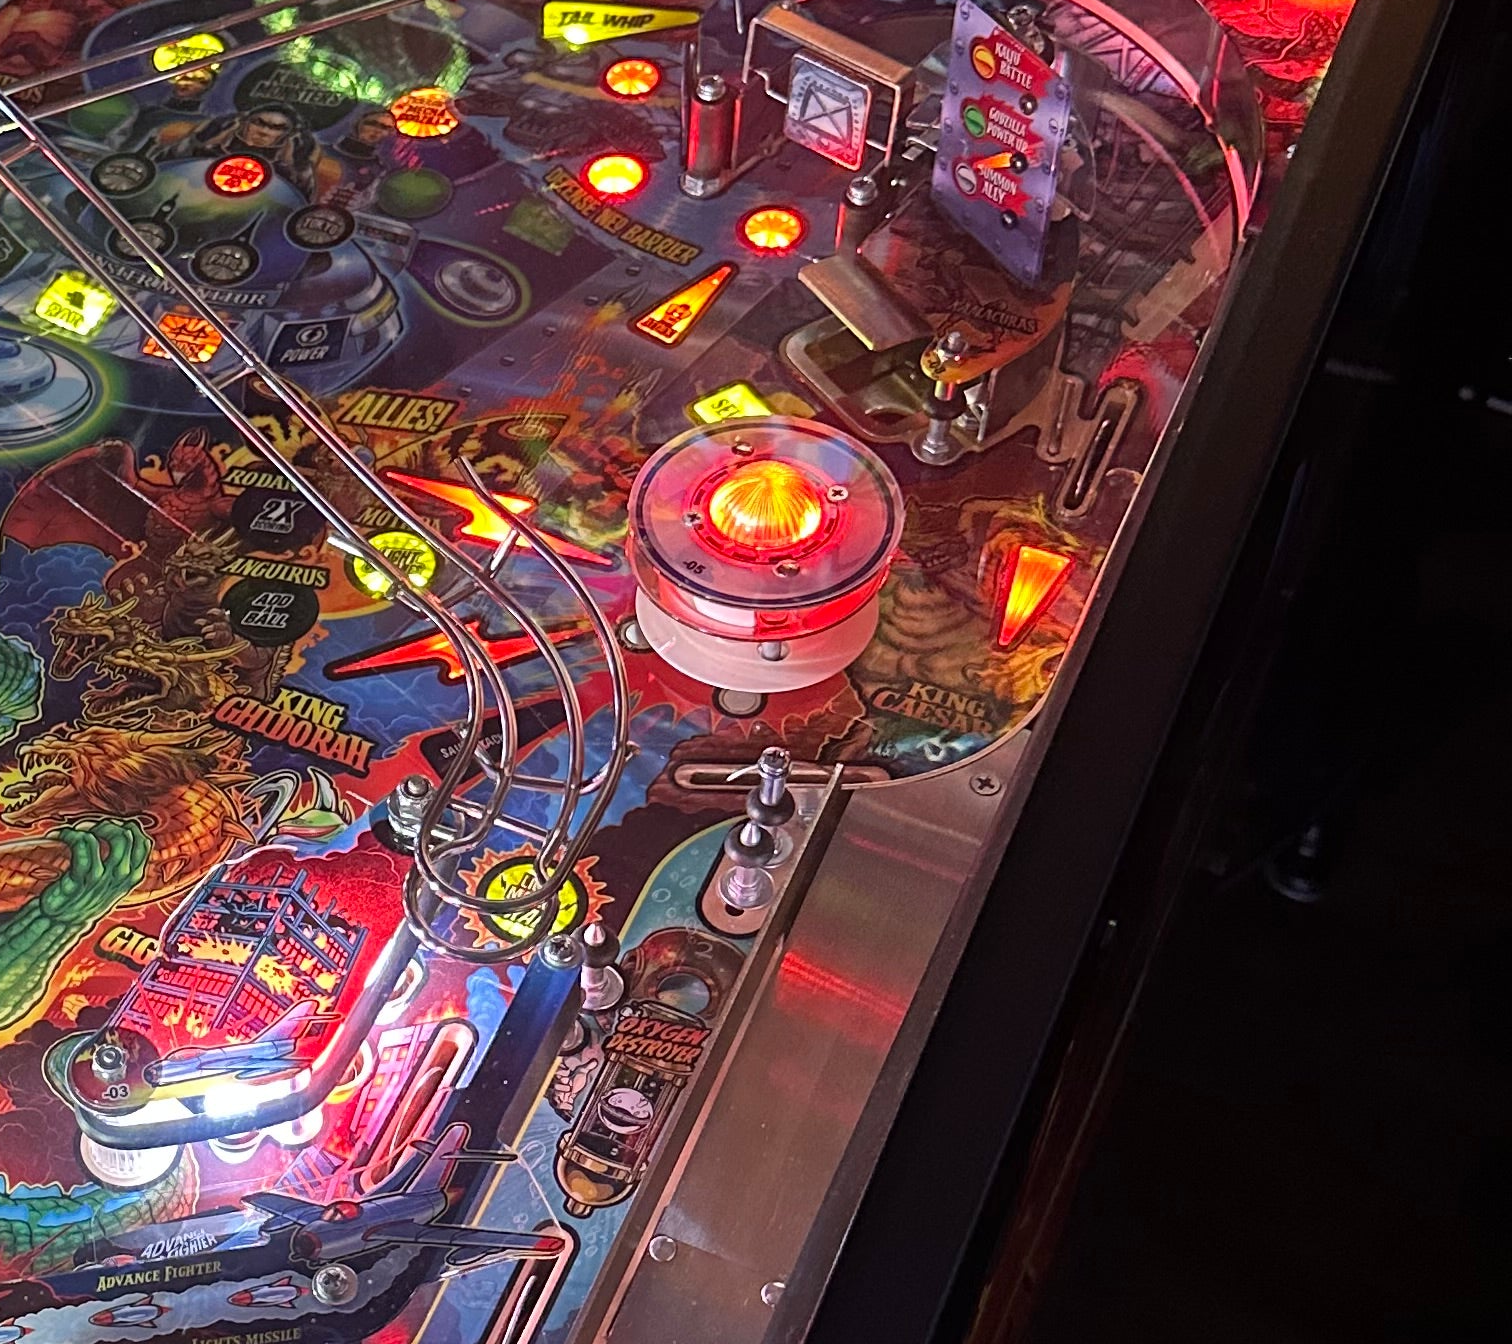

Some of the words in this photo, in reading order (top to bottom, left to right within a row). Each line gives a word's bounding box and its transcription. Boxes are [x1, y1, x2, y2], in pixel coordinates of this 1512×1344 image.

[558, 11, 597, 28] TAIL
[603, 13, 655, 28] WHIP
[994, 42, 1021, 66] KAIJU
[999, 59, 1033, 90] BATTLE
[989, 106, 1026, 137] GODZILLA
[987, 122, 1014, 147] POWER
[1015, 136, 1029, 154] UP
[977, 164, 1018, 196] SUMMON
[982, 182, 1007, 205] ALLY
[545, 167, 603, 218] DEFENSE
[621, 224, 702, 265] BARRIER
[280, 345, 329, 363] POWER
[343, 392, 452, 432] ALLIES!
[264, 498, 306, 524] 2X
[223, 559, 329, 587] ANGUIRUS
[683, 561, 706, 575] -05
[252, 592, 295, 606] ADD
[241, 611, 290, 628] BALL
[272, 688, 345, 729] KING
[871, 689, 994, 734] CAESAR
[908, 681, 988, 718] KING
[216, 696, 374, 773] GHIDORAH
[617, 1016, 710, 1045] OXYGEN
[610, 1033, 703, 1065] DESTROYER
[104, 1086, 128, 1099] -03
[96, 1269, 160, 1293] ADVANCE
[164, 1262, 223, 1283] FIGHTER
